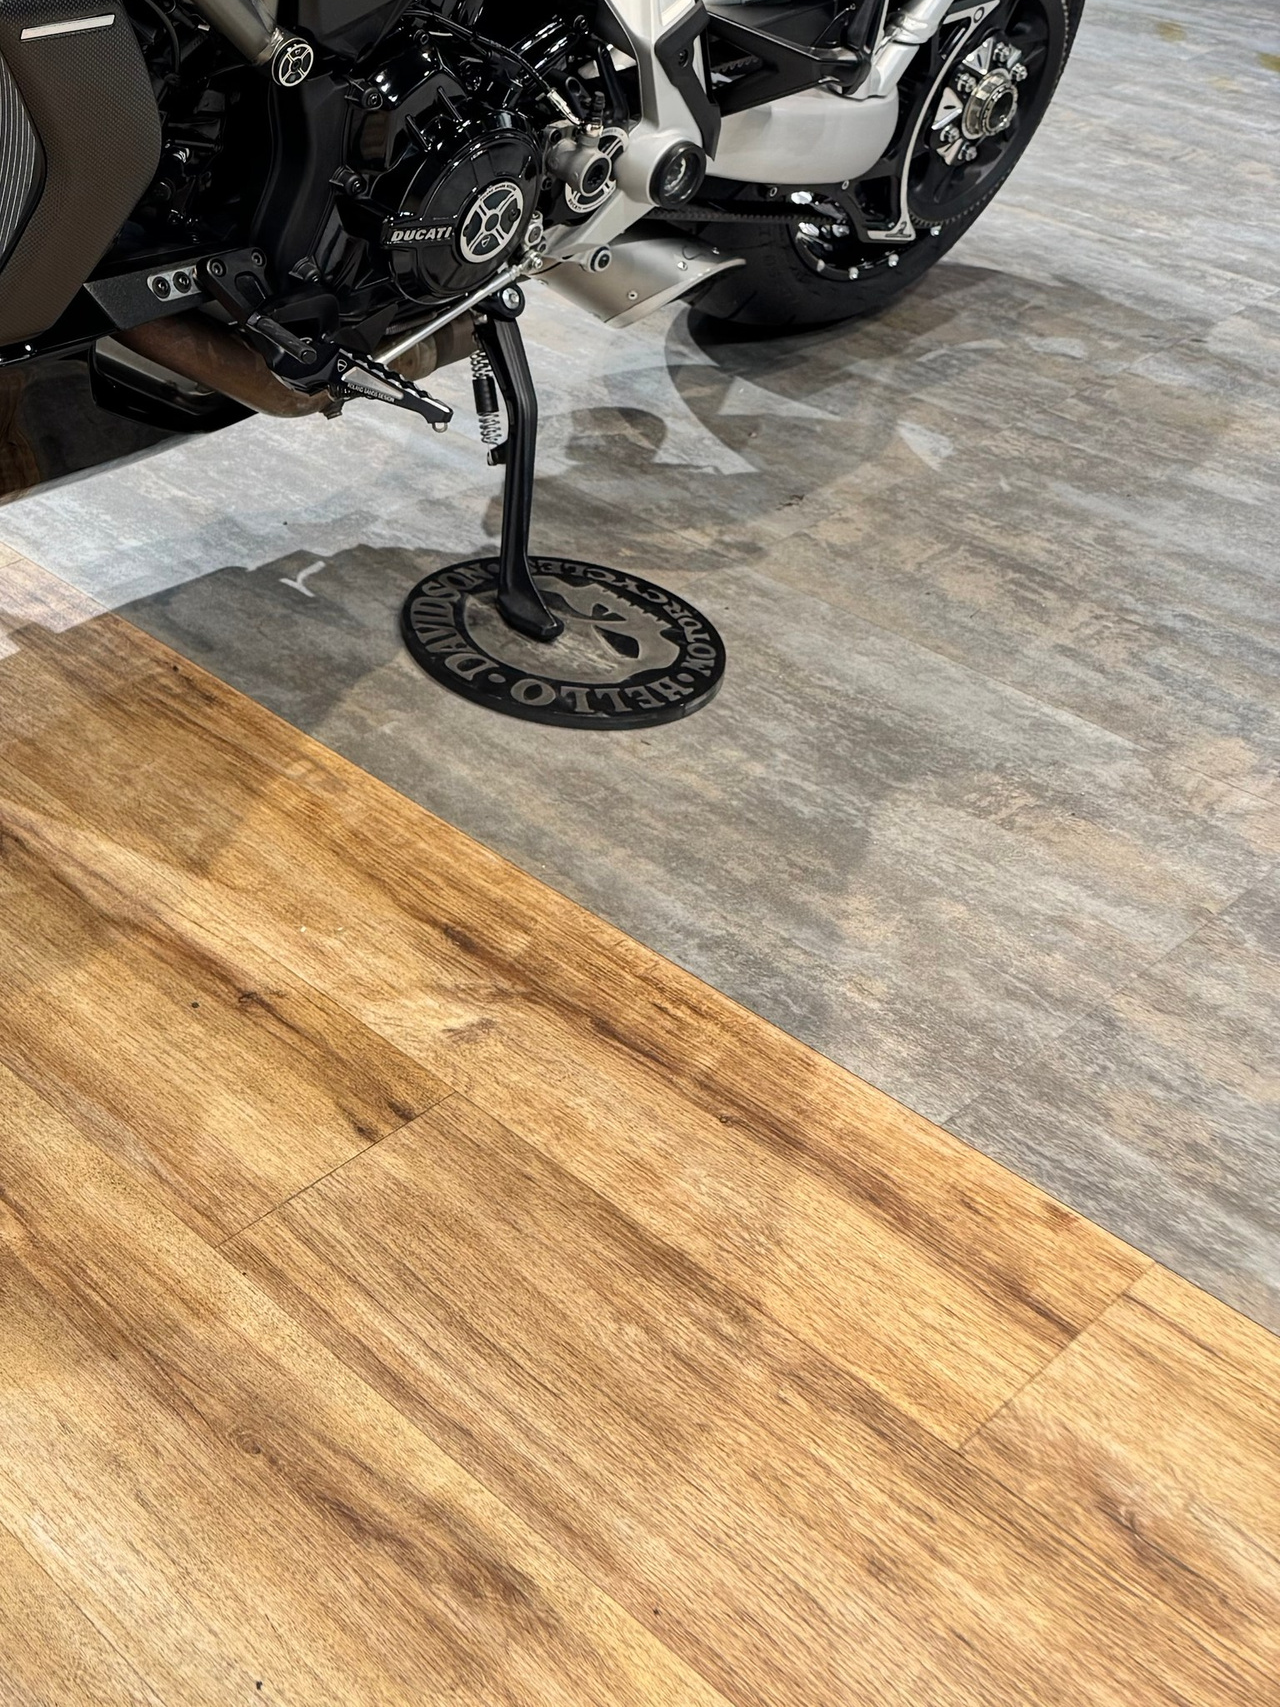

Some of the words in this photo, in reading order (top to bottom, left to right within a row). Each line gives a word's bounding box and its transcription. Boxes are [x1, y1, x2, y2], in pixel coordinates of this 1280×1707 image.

[390, 226, 452, 242] DUCATI
[410, 561, 500, 682] DAVIDSON
[509, 674, 695, 714] HELLO
